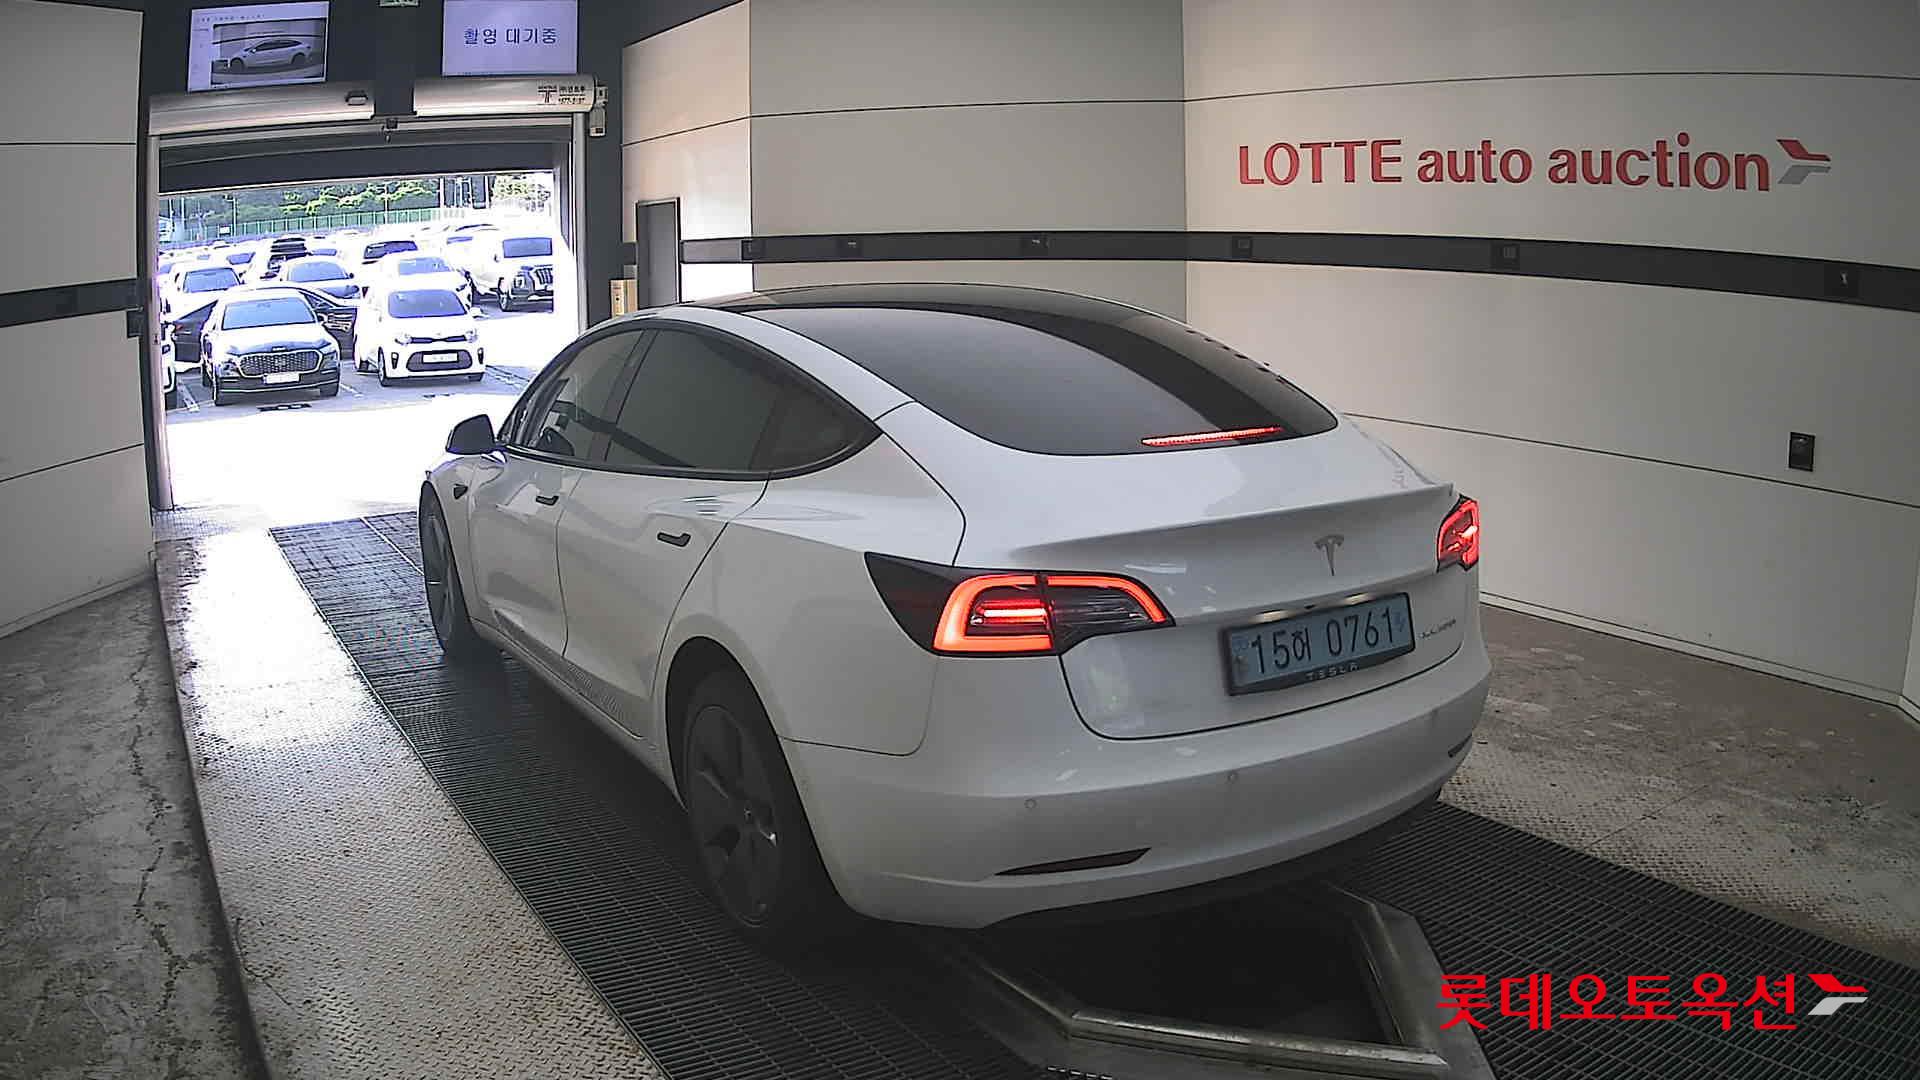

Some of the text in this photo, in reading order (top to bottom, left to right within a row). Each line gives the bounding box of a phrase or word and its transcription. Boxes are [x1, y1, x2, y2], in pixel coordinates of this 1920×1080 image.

[464, 28, 556, 45] 촬영 대기중
[1239, 132, 1770, 191] LOTTE auto auction
[1251, 627, 1311, 674] 15허
[1326, 607, 1393, 656] 0761
[1305, 662, 1360, 681] TESLA
